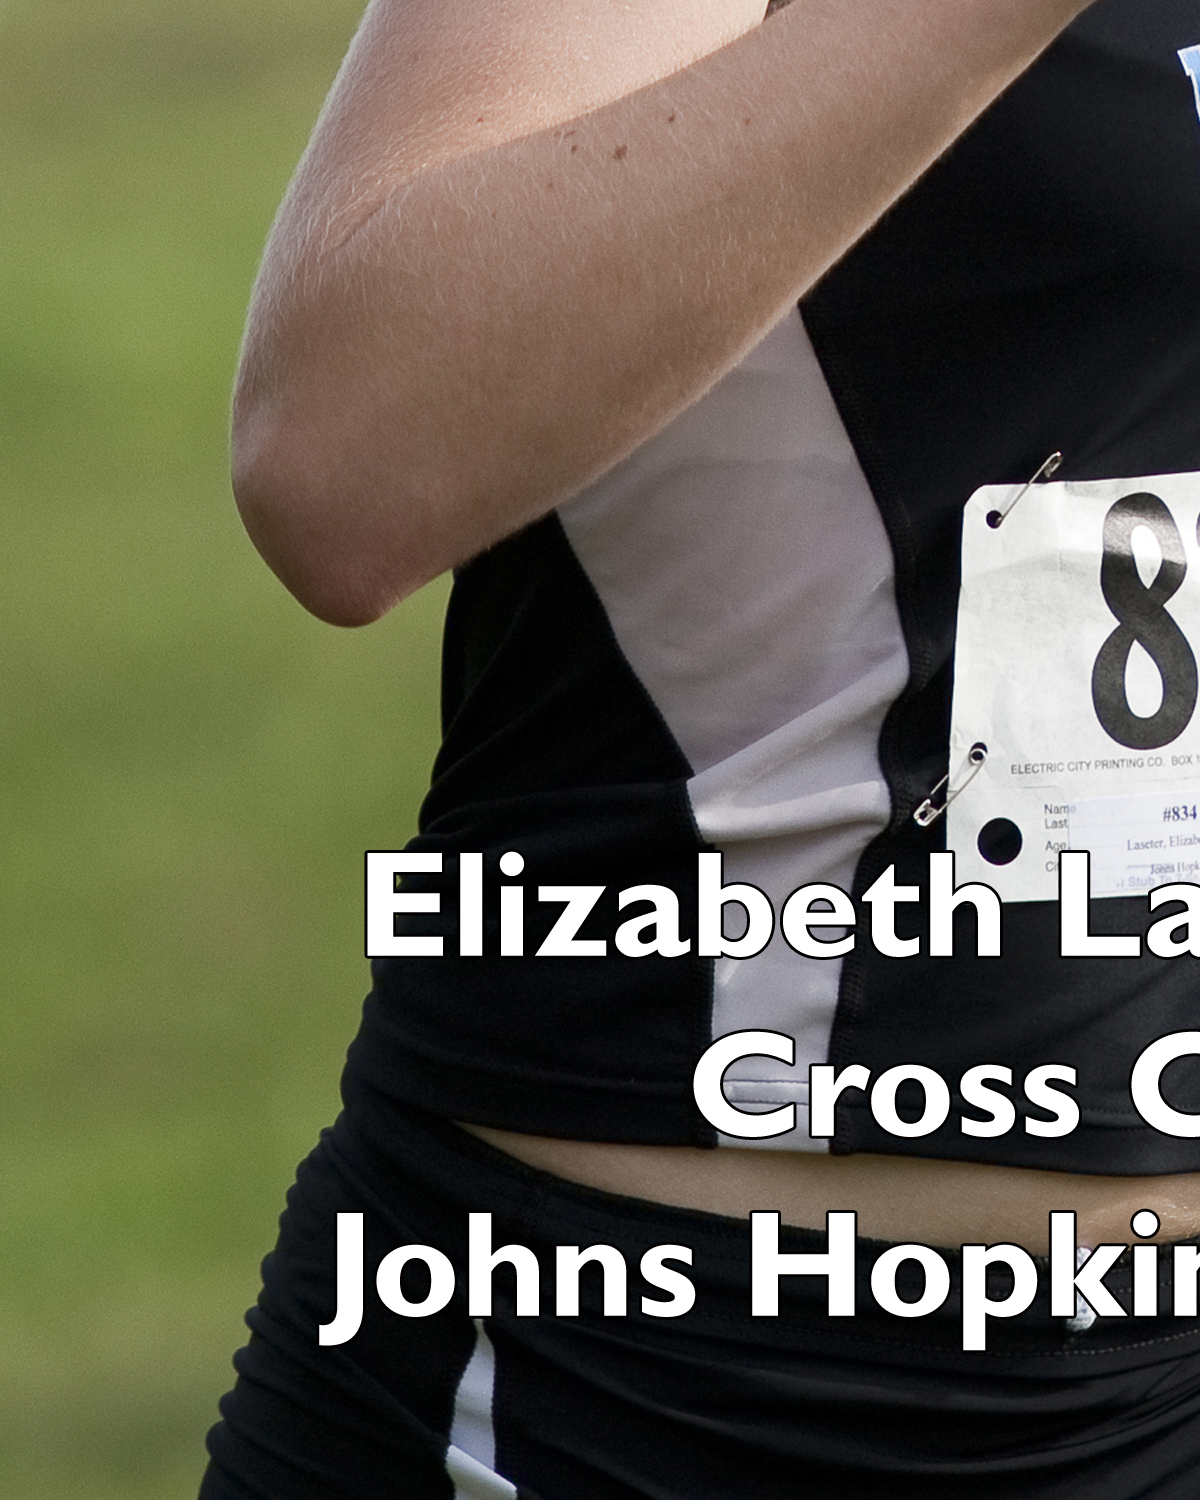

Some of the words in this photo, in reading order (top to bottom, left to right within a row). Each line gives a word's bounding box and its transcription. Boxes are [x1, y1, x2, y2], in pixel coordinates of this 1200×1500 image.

[1010, 761, 1065, 775] ELECTRIC
[1067, 760, 1092, 772] CITY
[1094, 757, 1144, 770] PRINTING
[1171, 754, 1193, 766] BOX
[1162, 804, 1198, 822] #834
[1044, 818, 1069, 830] Last
[1126, 837, 1167, 852] Laseter,
